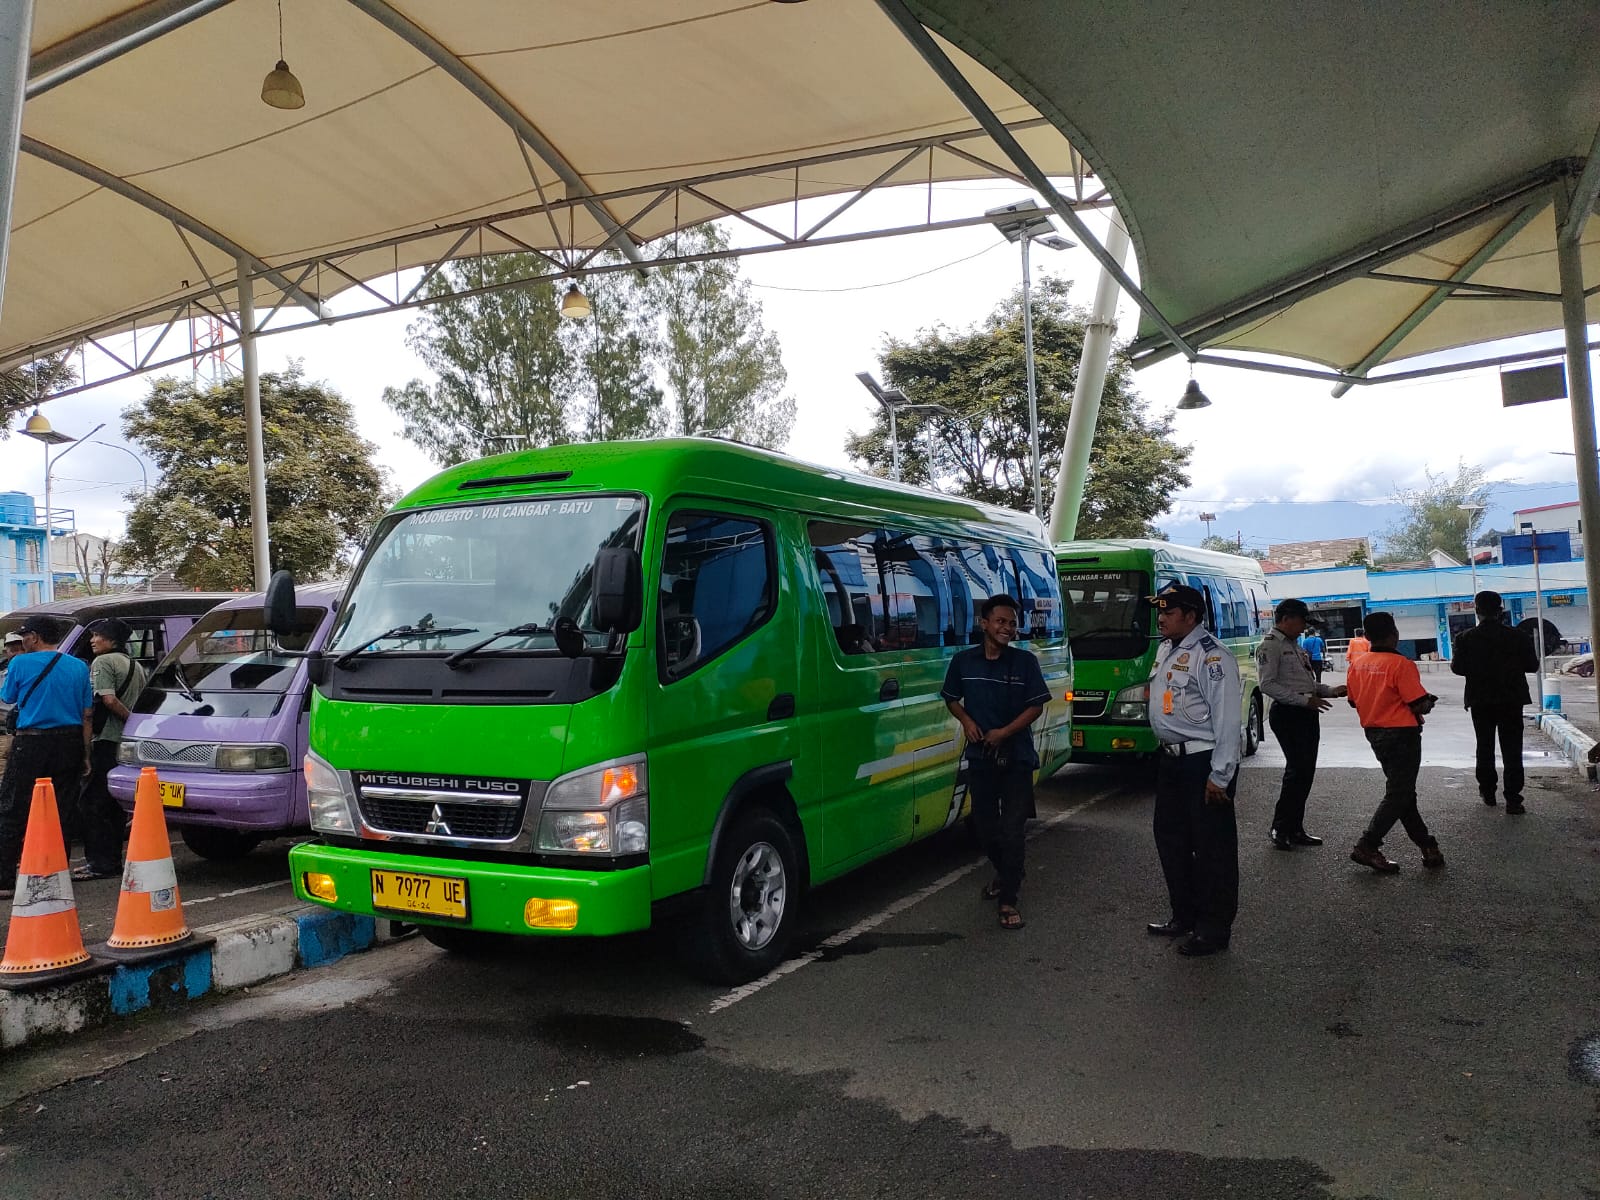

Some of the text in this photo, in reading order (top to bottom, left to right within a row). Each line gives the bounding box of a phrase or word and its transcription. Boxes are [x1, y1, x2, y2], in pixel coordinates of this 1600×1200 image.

[410, 510, 473, 525] MOJOKERTO
[481, 507, 500, 519] VIA
[502, 504, 550, 518] CANGAR
[559, 502, 592, 515] BATU
[171, 784, 182, 799] UK
[359, 774, 519, 792] MITSUBISHI FUSO
[375, 873, 461, 903] N 7977 UE
